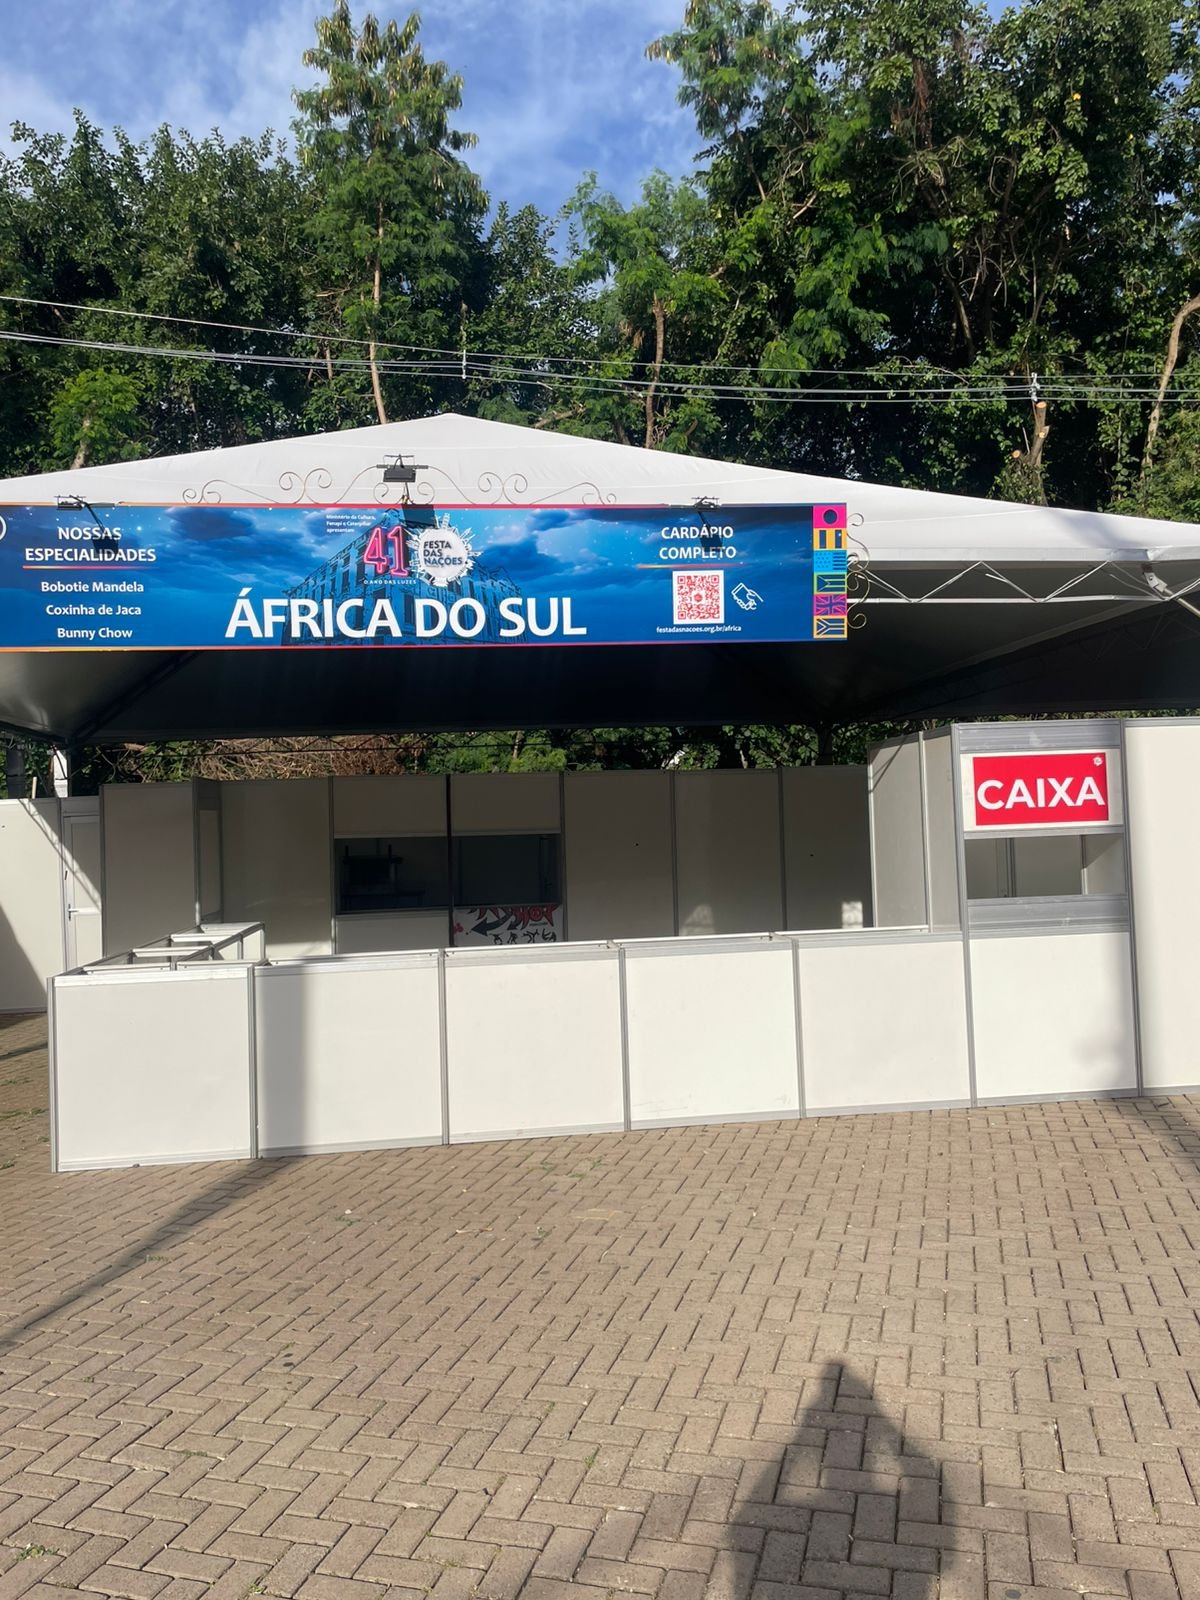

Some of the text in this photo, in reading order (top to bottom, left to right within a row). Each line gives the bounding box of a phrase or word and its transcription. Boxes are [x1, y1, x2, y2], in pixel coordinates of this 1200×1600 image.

[57, 526, 122, 541] NOSSAS
[660, 524, 734, 540] CARDÁPIO
[363, 525, 409, 577] 41
[423, 540, 453, 549] FESTA
[25, 548, 157, 562] ESPECIALIDADES
[423, 548, 444, 557] DAS
[659, 546, 737, 560] COMPLETO
[423, 555, 463, 567] NAÇÕES
[41, 581, 144, 593] Bobotie Mandela
[46, 604, 142, 616] Coxinha de Jaca
[224, 587, 588, 639] ÁFRICA DO SUL
[57, 627, 133, 641] Bunny Chow
[656, 624, 742, 634] festadasnacoes.org.br/africa
[976, 776, 1106, 811] CAIXA
